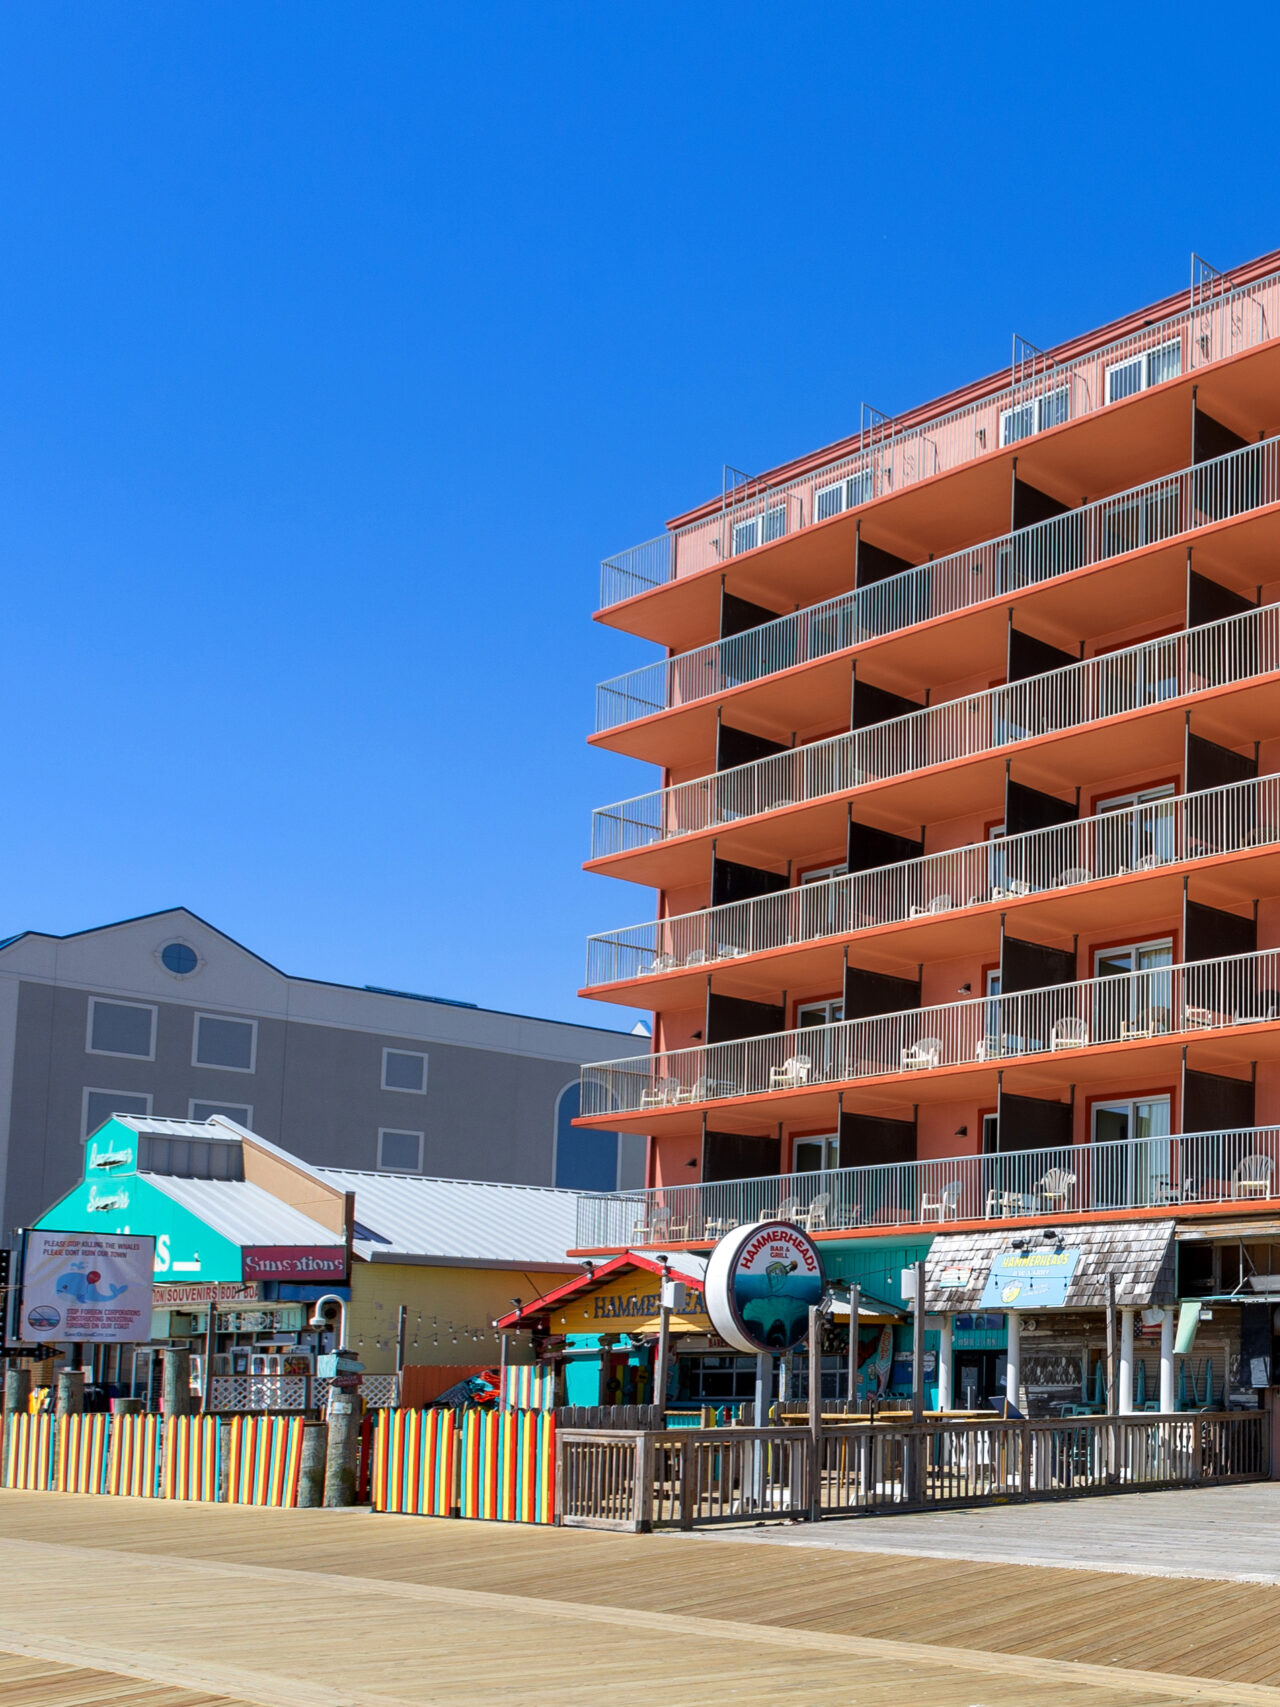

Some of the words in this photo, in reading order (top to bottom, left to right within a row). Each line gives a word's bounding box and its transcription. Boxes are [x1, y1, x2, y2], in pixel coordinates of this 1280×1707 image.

[43, 1239, 66, 1248] PLEASE
[66, 1240, 80, 1248] STOP
[81, 1241, 103, 1249] KILLING
[118, 1243, 140, 1251] WHALES
[43, 1248, 64, 1256] PLEASE
[740, 1230, 817, 1272] HAMMERHEADS
[1001, 1253, 1070, 1268] HAMMERHEADS
[167, 1286, 218, 1302] SOUVENIRS
[220, 1285, 242, 1299] BODY
